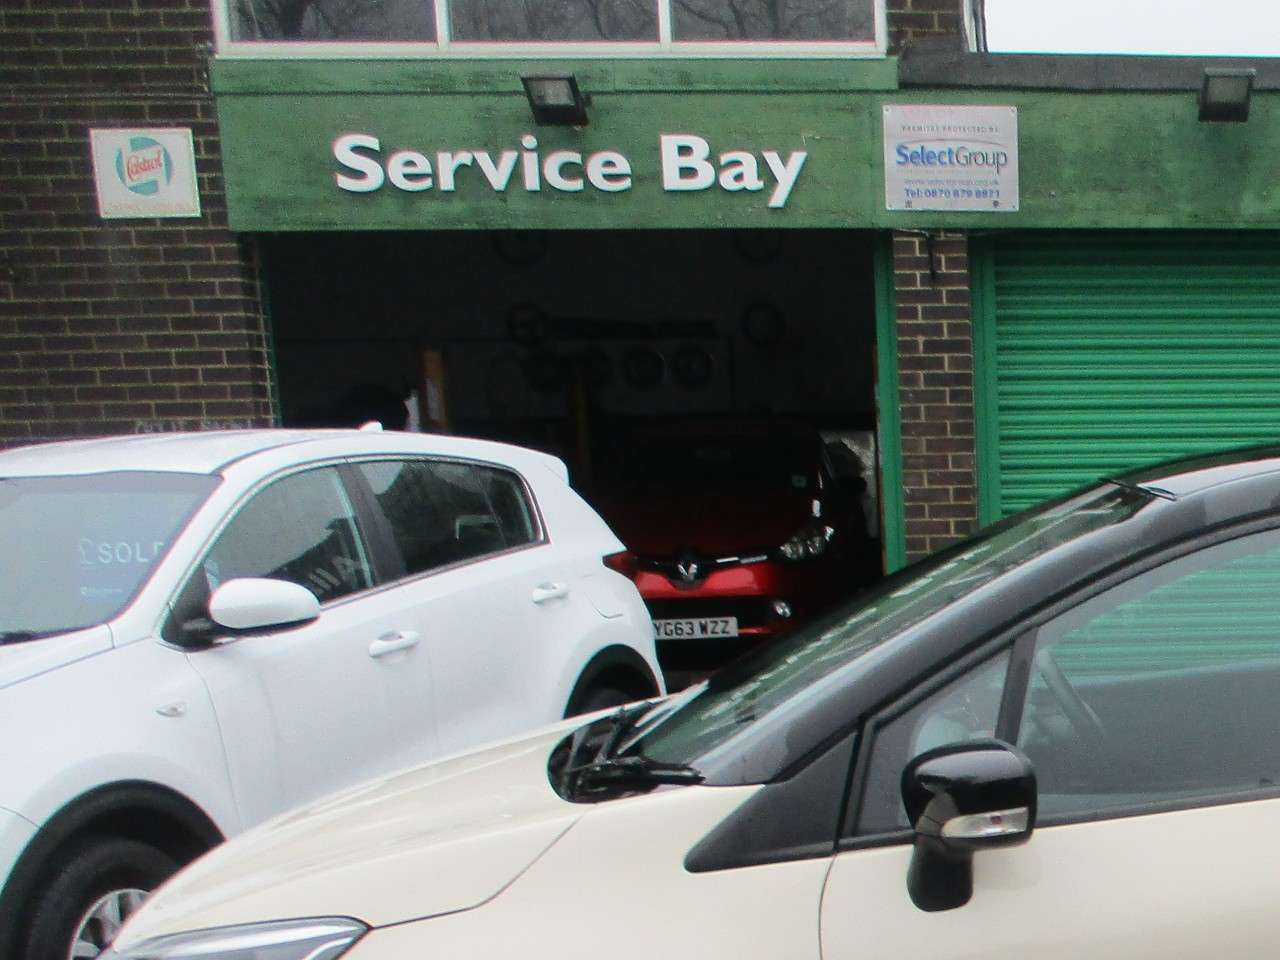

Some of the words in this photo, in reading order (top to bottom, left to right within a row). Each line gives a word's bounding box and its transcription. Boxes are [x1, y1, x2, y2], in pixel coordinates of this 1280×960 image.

[333, 134, 633, 193] Service
[659, 134, 808, 208] Bay
[895, 143, 1008, 174] SelectGroup
[654, 622, 695, 636] YG63
